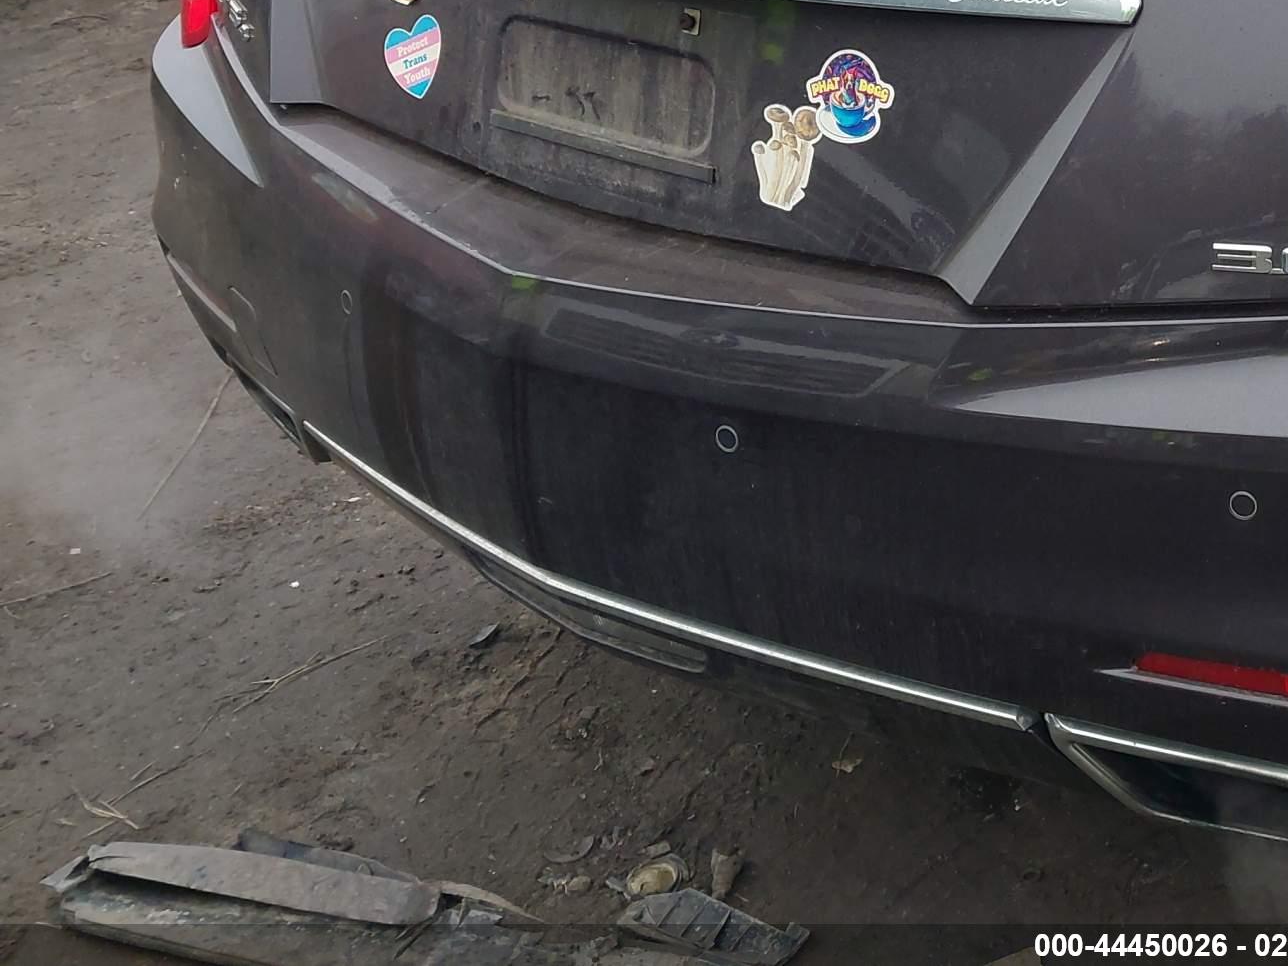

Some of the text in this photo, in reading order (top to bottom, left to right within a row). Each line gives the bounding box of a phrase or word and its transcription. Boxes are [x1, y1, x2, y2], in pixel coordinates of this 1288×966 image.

[397, 36, 429, 58] Protect
[403, 53, 428, 69] Trans
[404, 67, 431, 85] Youth
[811, 77, 840, 97] PHAT
